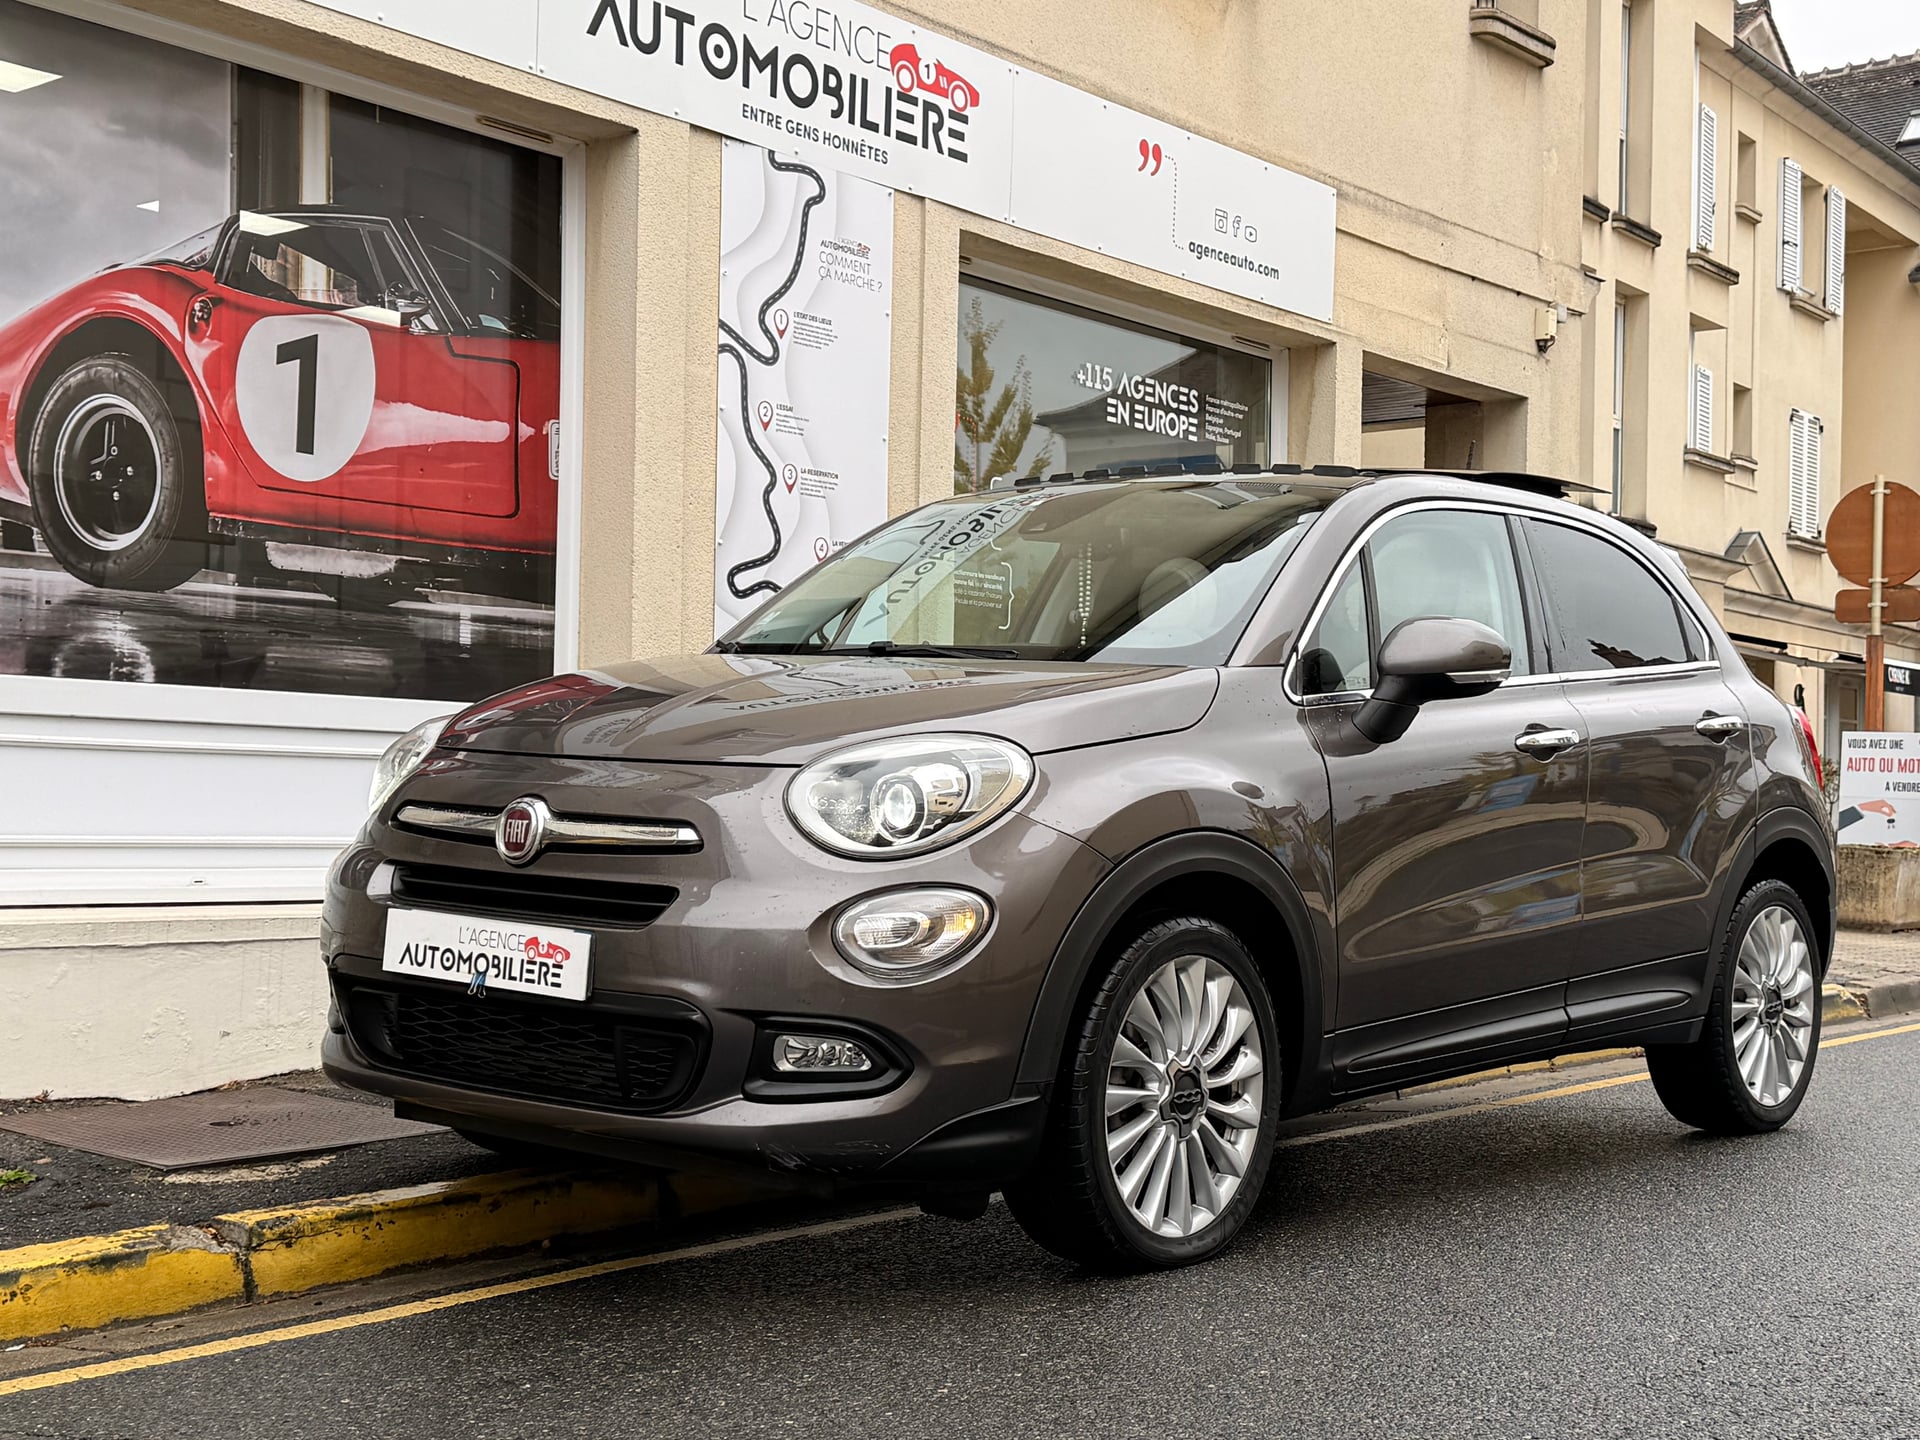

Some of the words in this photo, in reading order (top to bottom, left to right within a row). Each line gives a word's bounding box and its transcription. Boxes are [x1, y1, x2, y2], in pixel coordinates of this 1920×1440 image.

[742, 103, 783, 132] ENTRE
[785, 119, 820, 143] GENS
[823, 131, 889, 165] HONNÊTES
[819, 251, 871, 276] COMMENT
[1188, 240, 1280, 281] agenceauto.com
[818, 265, 832, 281] ÇA
[834, 270, 875, 292] MARCHE
[275, 333, 319, 456] 1
[1077, 362, 1113, 392] +115
[1117, 371, 1199, 414] AGENCES
[762, 405, 769, 418] 2
[1107, 397, 1131, 427] EN
[1134, 403, 1199, 442] EUROPE
[787, 468, 793, 480] 3
[819, 543, 824, 553] 4
[1847, 738, 1867, 749] VOUS
[1869, 738, 1887, 750] AVEZ
[1889, 739, 1904, 750] UNE
[1847, 757, 1875, 773] AUTO
[1879, 757, 1894, 773] OU
[1884, 781, 1891, 792] A
[505, 819, 530, 843] FIAT
[458, 926, 527, 953] L'AGENCE
